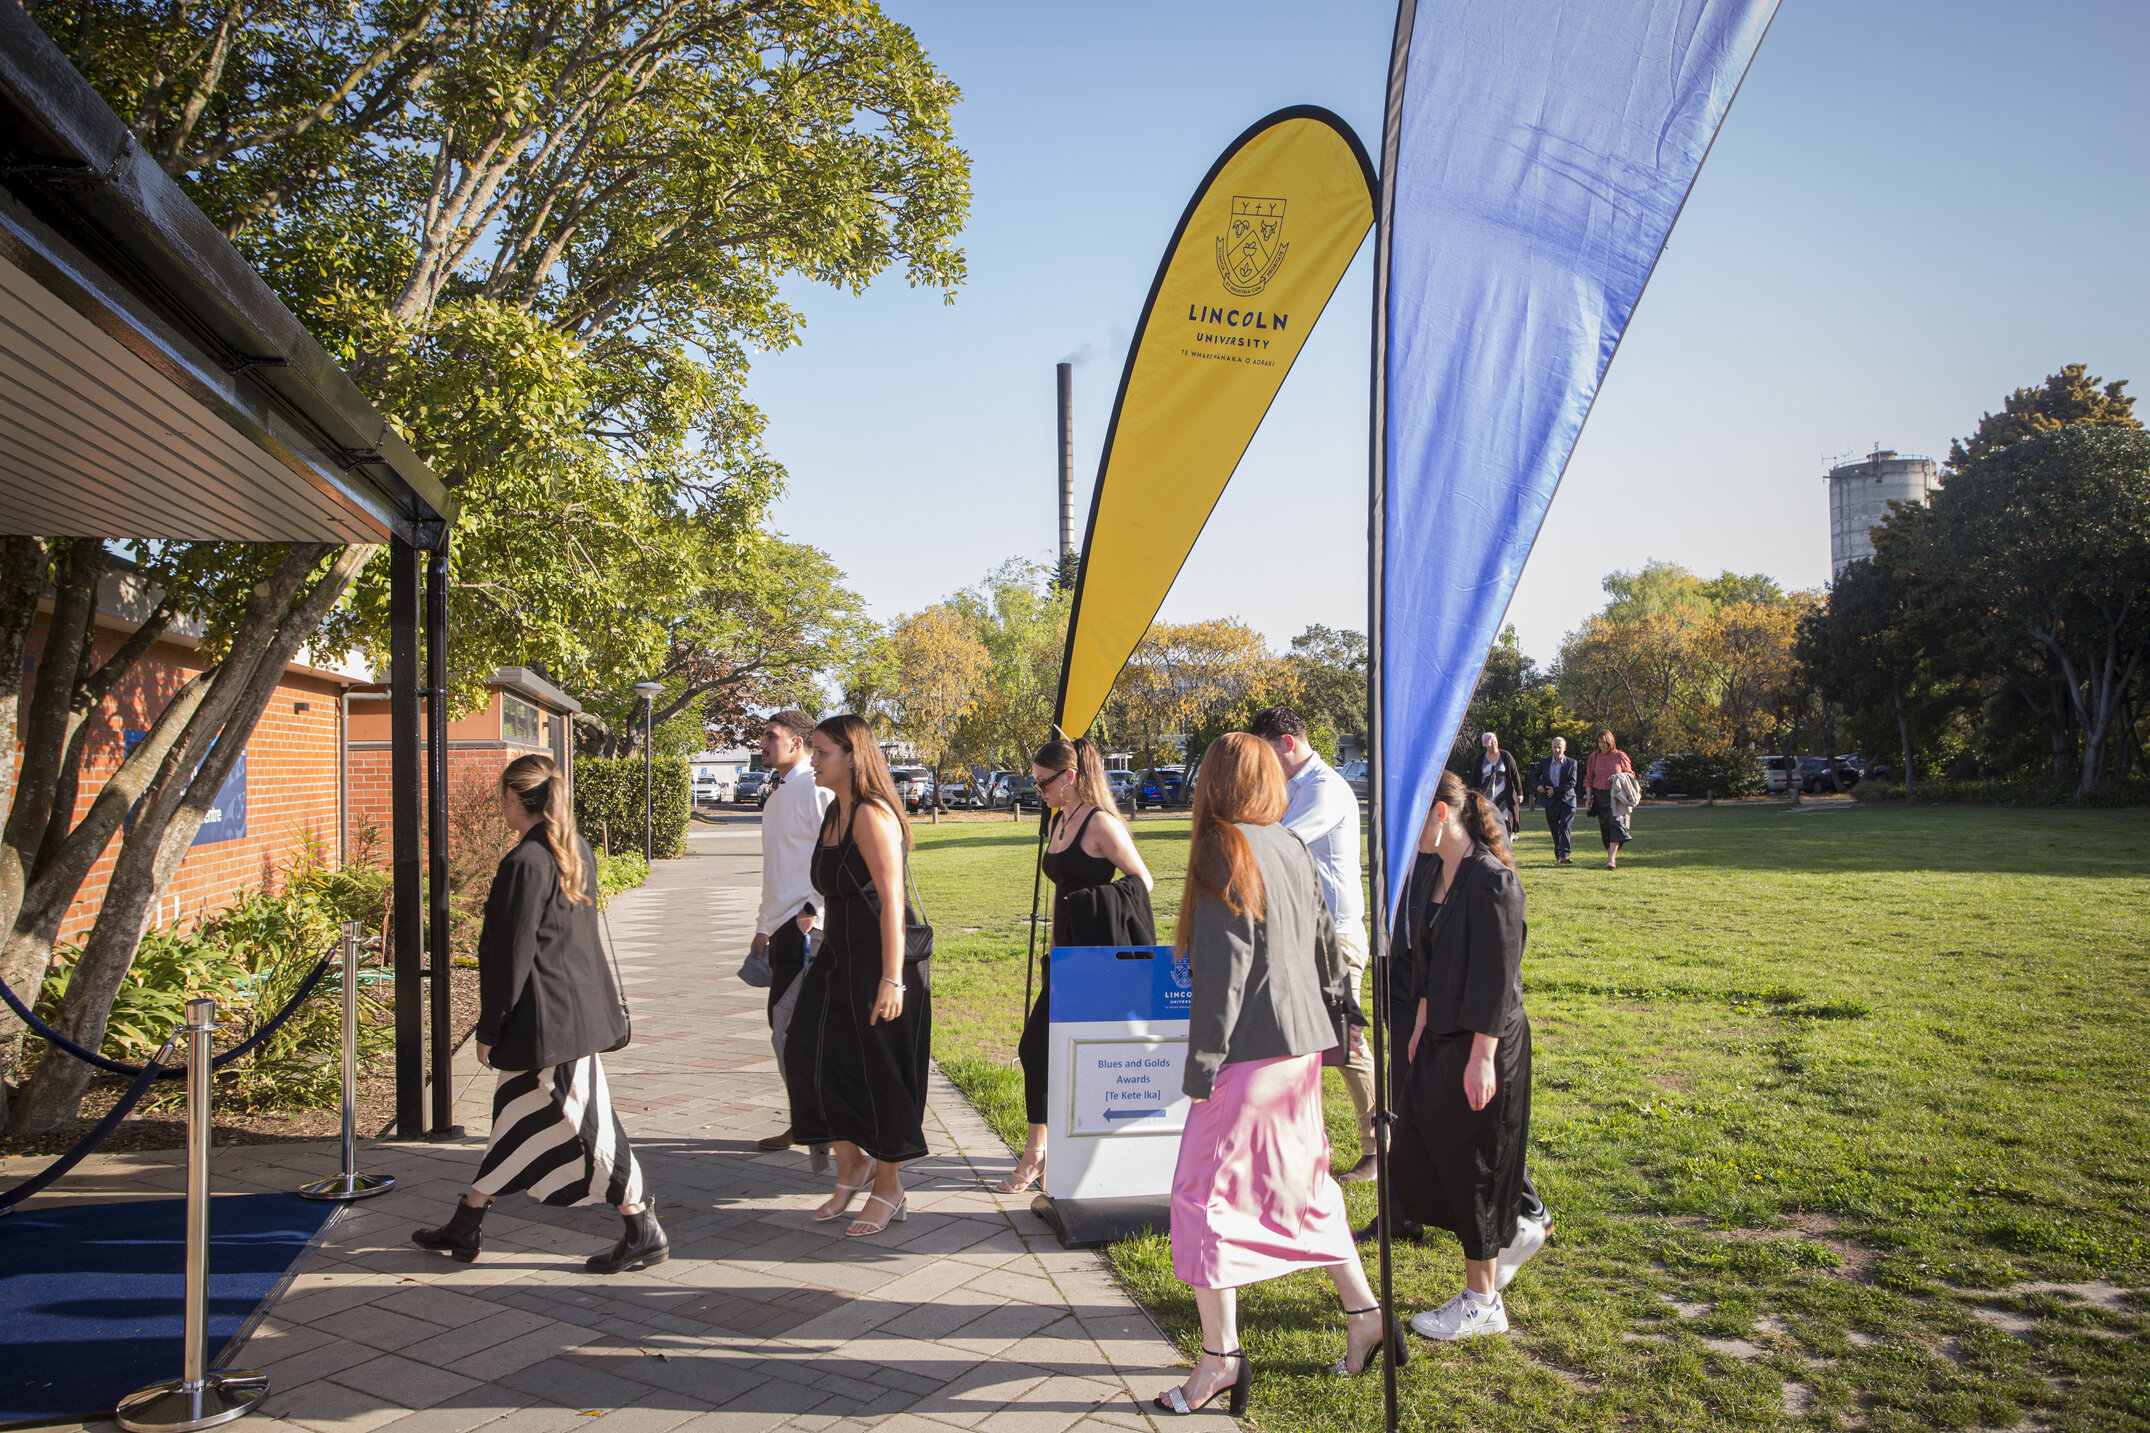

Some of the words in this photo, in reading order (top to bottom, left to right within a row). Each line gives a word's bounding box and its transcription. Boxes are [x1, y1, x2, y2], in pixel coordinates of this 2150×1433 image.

[1188, 304, 1288, 331] LINCOLN
[1196, 332, 1270, 349] UNIVERSITY
[1191, 351, 1213, 360] WHARE
[1252, 359, 1275, 367] AORAKI
[202, 806, 222, 824] entre
[1164, 991, 1193, 999] LINCO
[1098, 1059, 1123, 1069] Blues
[1125, 1058, 1142, 1068] and
[1144, 1058, 1171, 1068] Golds
[1116, 1074, 1151, 1085] Awards
[1105, 1091, 1119, 1102] [Te
[1121, 1091, 1142, 1100] Kete
[1144, 1089, 1161, 1101] Ika]
